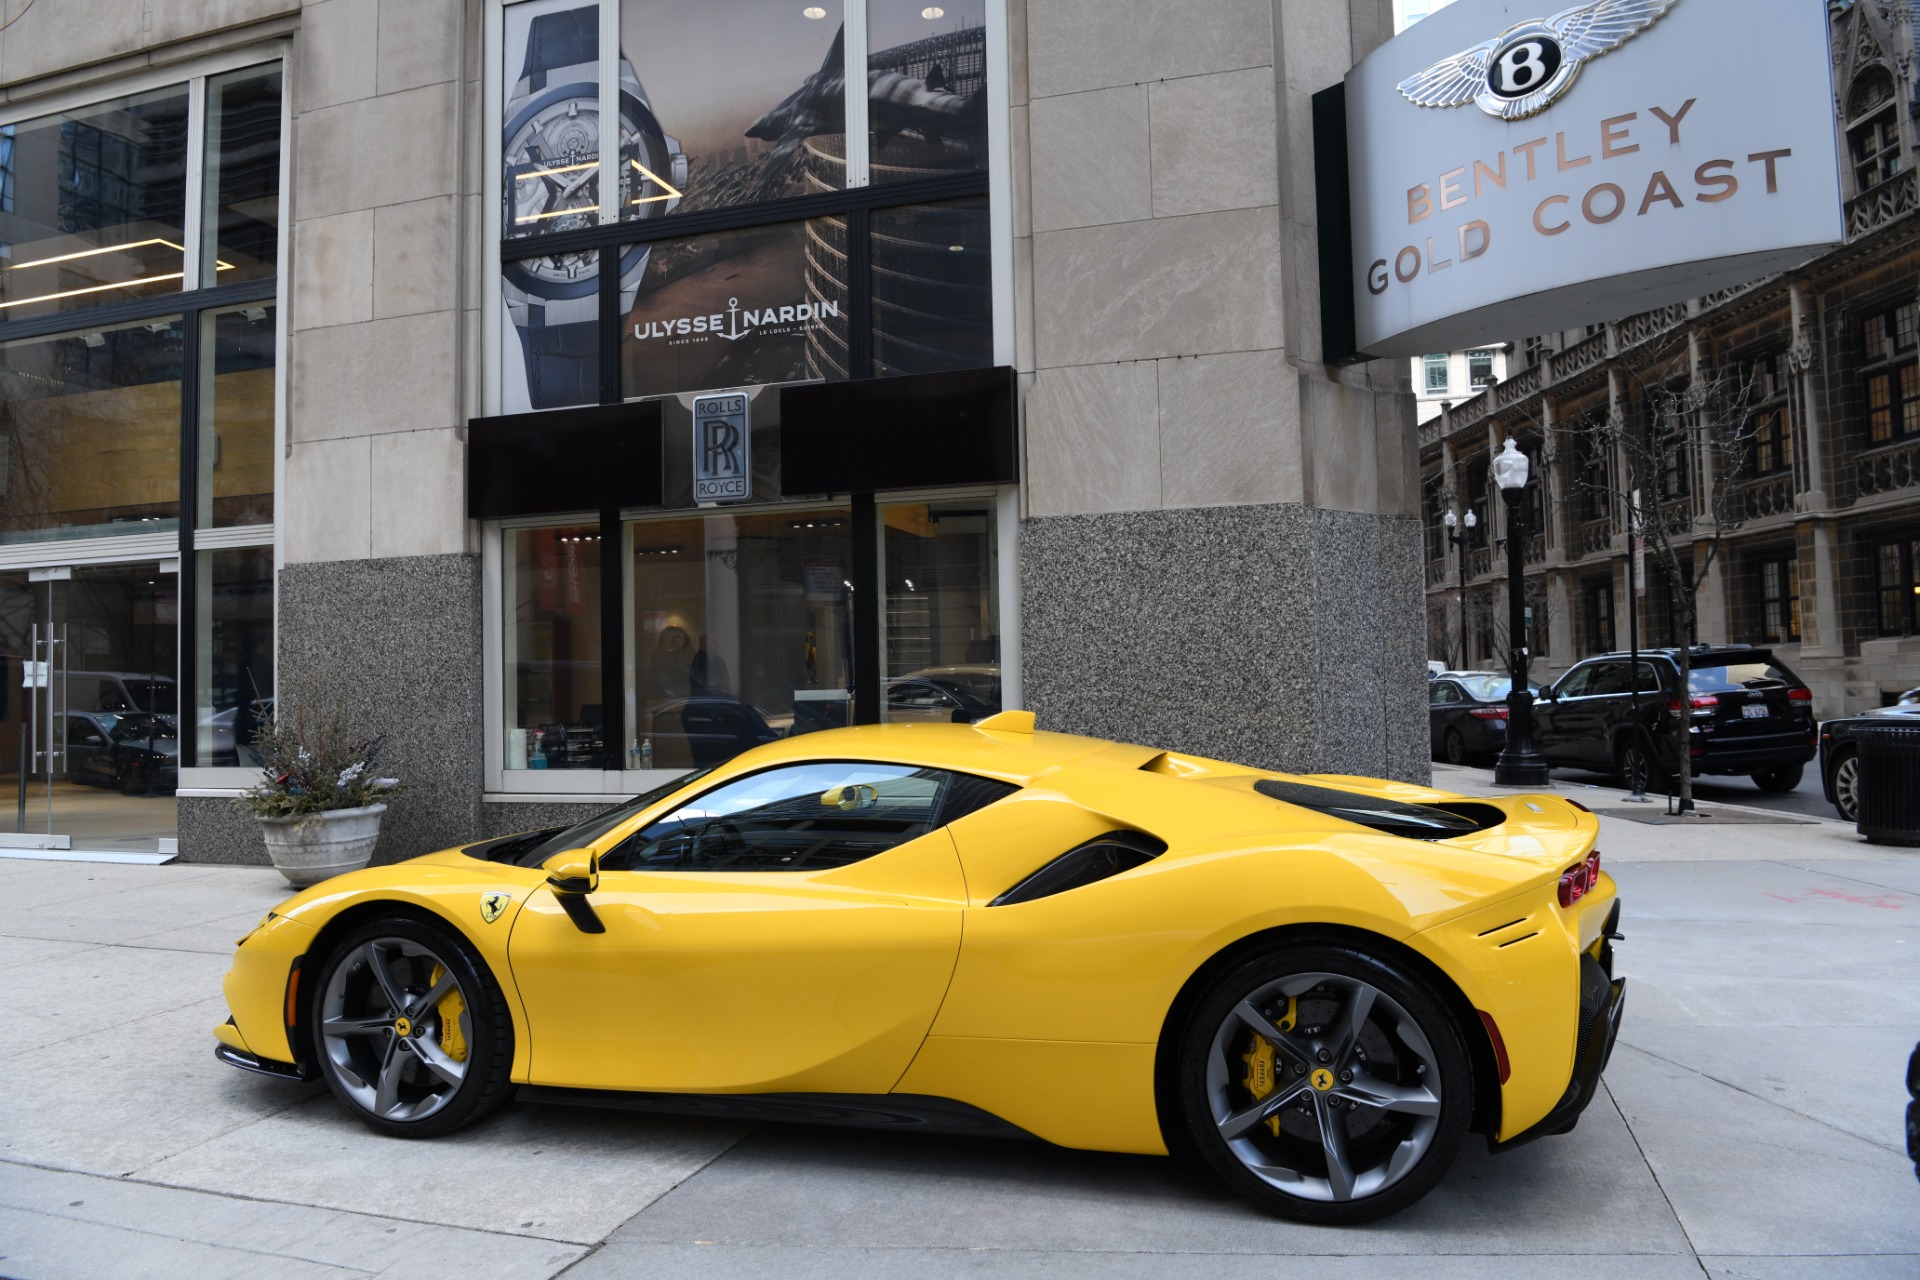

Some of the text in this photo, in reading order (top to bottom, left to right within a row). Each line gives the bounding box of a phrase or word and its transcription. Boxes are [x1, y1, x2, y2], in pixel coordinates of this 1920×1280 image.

[1498, 42, 1546, 92] B
[543, 157, 570, 167] ULYSSE
[1406, 98, 1697, 225] BENTLEY
[1367, 148, 1792, 296] GOLD COAST
[634, 300, 838, 340] ULYSSE NARDIN
[698, 399, 743, 415] ROLLS
[699, 480, 743, 495] ROYCE
